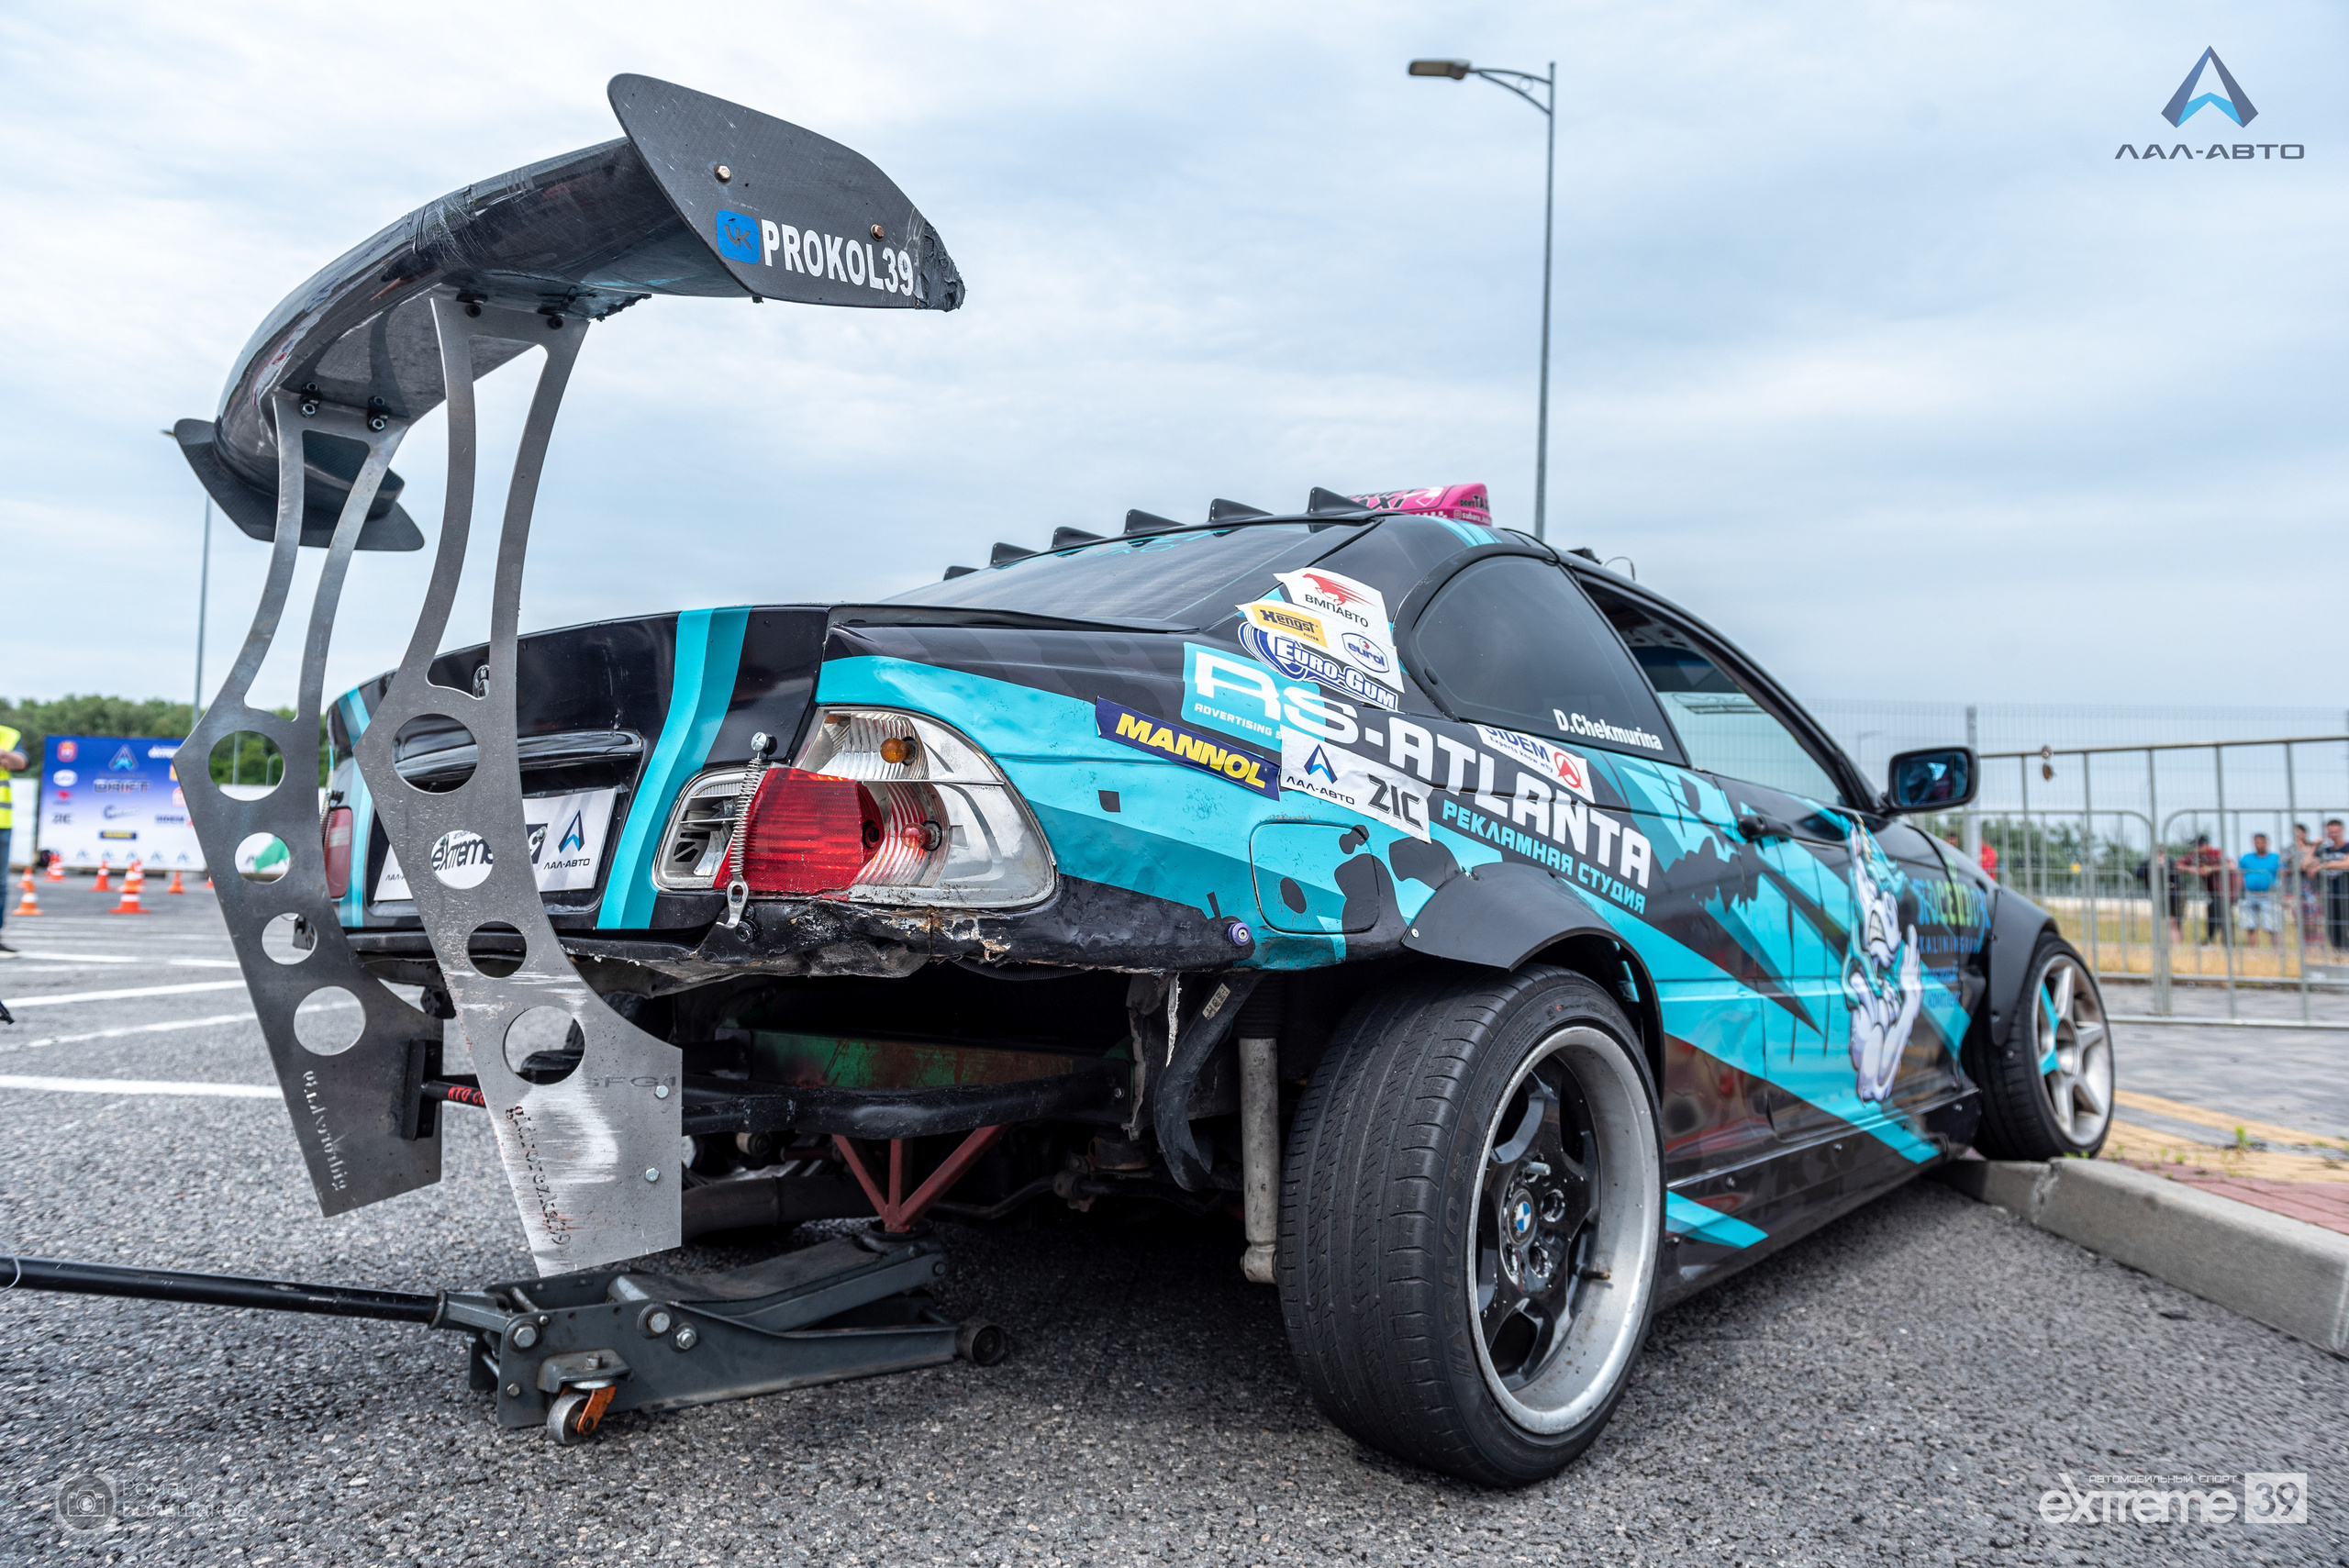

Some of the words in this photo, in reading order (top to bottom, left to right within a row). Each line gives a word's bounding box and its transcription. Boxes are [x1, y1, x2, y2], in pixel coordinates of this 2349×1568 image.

[761, 218, 914, 296] PROKOL39
[1260, 609, 1315, 633] Hengst
[1305, 594, 1369, 628] ВМПАВТО
[1348, 642, 1386, 667] eurol
[1195, 703, 1273, 737] ADVERTISING
[1553, 708, 1664, 751] D.Chekmurina
[1115, 713, 1265, 788] MANNOL
[1490, 736, 1519, 754] Experts
[1520, 751, 1538, 763] know
[1541, 762, 1553, 773] why
[1195, 651, 1652, 889] RS-ATLANTA
[1286, 775, 1354, 805] ЛАЛ-АВТО
[1367, 773, 1424, 830] ZIC
[543, 858, 591, 871] ЛАЛ-АВТО
[1442, 799, 1574, 876] РЕКЛАМНАЯ
[1577, 862, 1647, 915] СТУДИЯ
[1919, 935, 1982, 954] KALININGRAD
